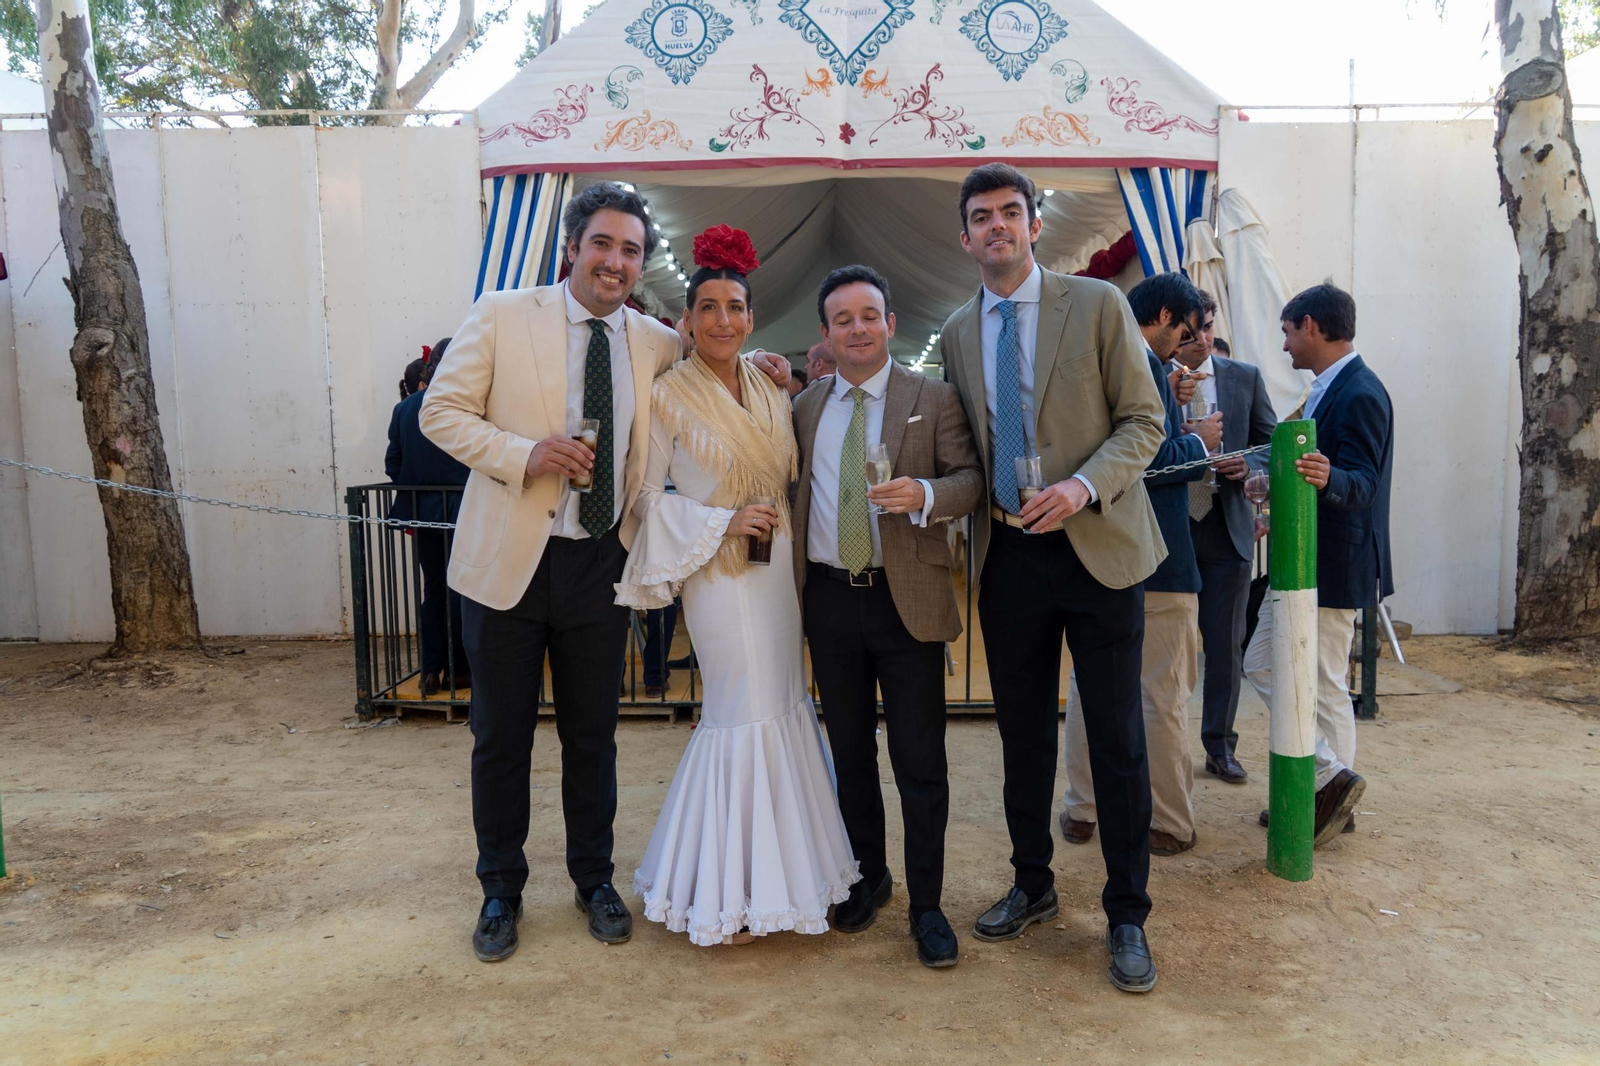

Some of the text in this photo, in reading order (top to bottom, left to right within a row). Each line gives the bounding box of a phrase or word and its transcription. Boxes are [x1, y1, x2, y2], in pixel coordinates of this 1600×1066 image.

[818, 5, 877, 19] La Fresquita
[664, 42, 694, 50] HUELVA
